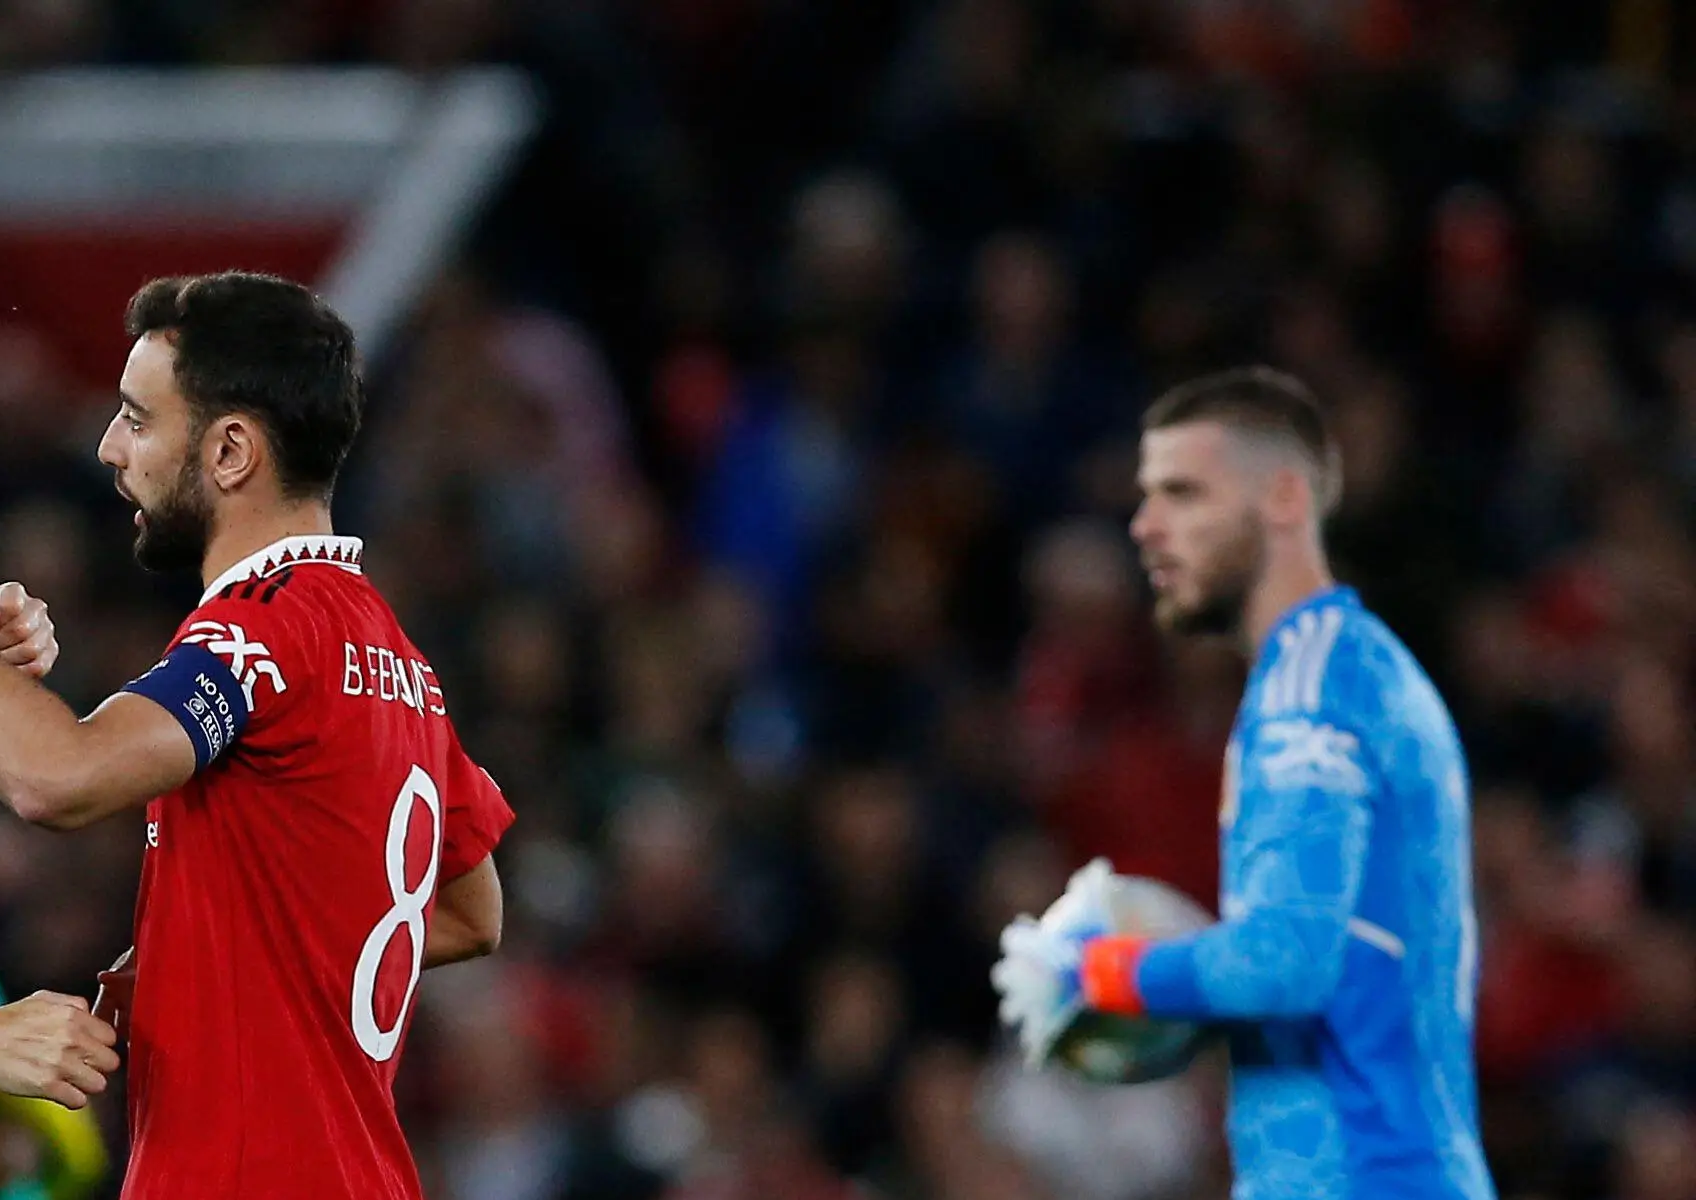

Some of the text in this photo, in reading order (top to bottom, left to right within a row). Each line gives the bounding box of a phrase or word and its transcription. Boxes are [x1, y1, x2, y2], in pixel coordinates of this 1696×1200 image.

[195, 672, 218, 696] NO
[214, 692, 230, 716] TO
[352, 763, 441, 1063] 8
